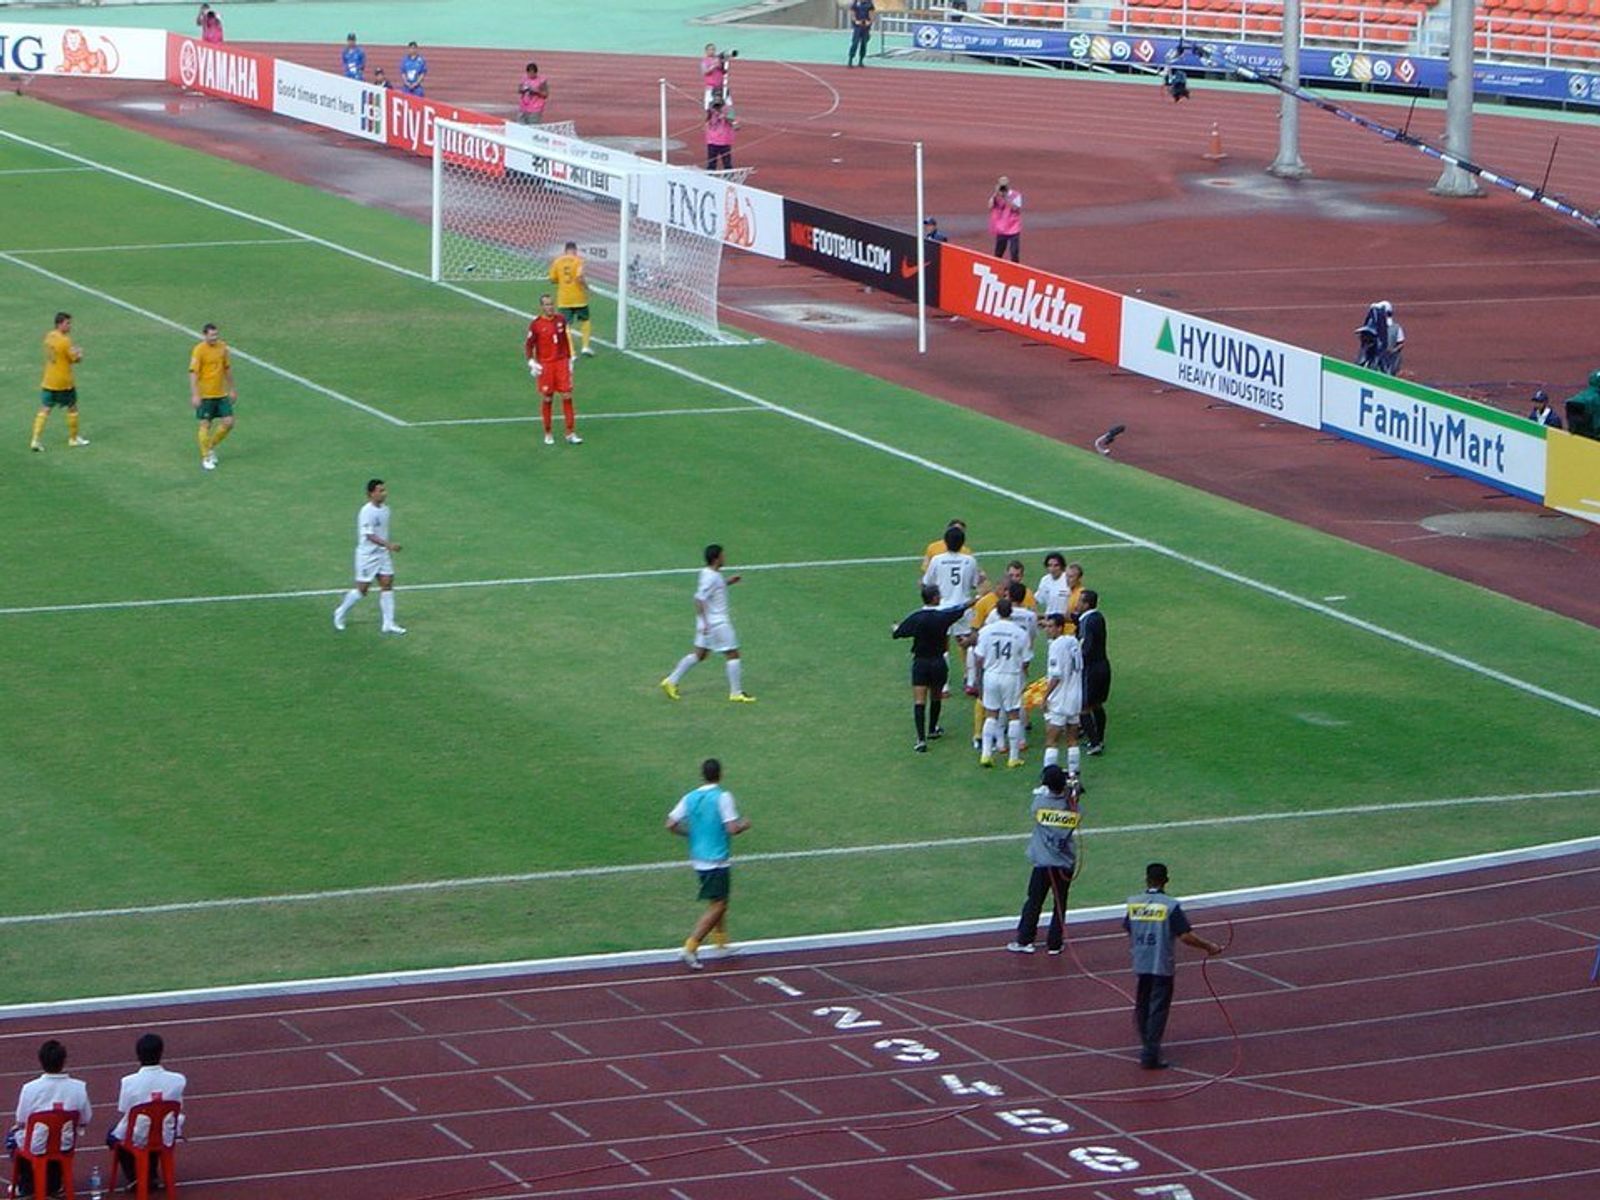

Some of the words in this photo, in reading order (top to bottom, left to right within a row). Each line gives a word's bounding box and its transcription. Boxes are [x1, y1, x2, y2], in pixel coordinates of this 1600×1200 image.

[963, 35, 980, 45] CUP
[1248, 55, 1266, 65] CUP
[197, 45, 258, 100] YAMAHA
[277, 79, 297, 99] Good
[297, 86, 318, 105] times
[319, 94, 338, 111] start
[392, 97, 420, 150] Fly
[667, 180, 717, 236] ING
[1180, 323, 1285, 388] HYUNDAI
[1178, 362, 1217, 390] HEAVY
[1218, 375, 1285, 411] INDUSTRIES
[1359, 387, 1504, 473] FamilyMart
[951, 566, 961, 586] 5
[992, 640, 1013, 660] 14
[1041, 812, 1077, 825] Nikon
[1131, 906, 1166, 918] Nikon
[753, 976, 805, 997] 1
[812, 1005, 884, 1029] 2
[873, 1038, 941, 1062] 3
[940, 1074, 1005, 1097] 4
[993, 1108, 1070, 1135] 5
[1068, 1146, 1141, 1173] 6
